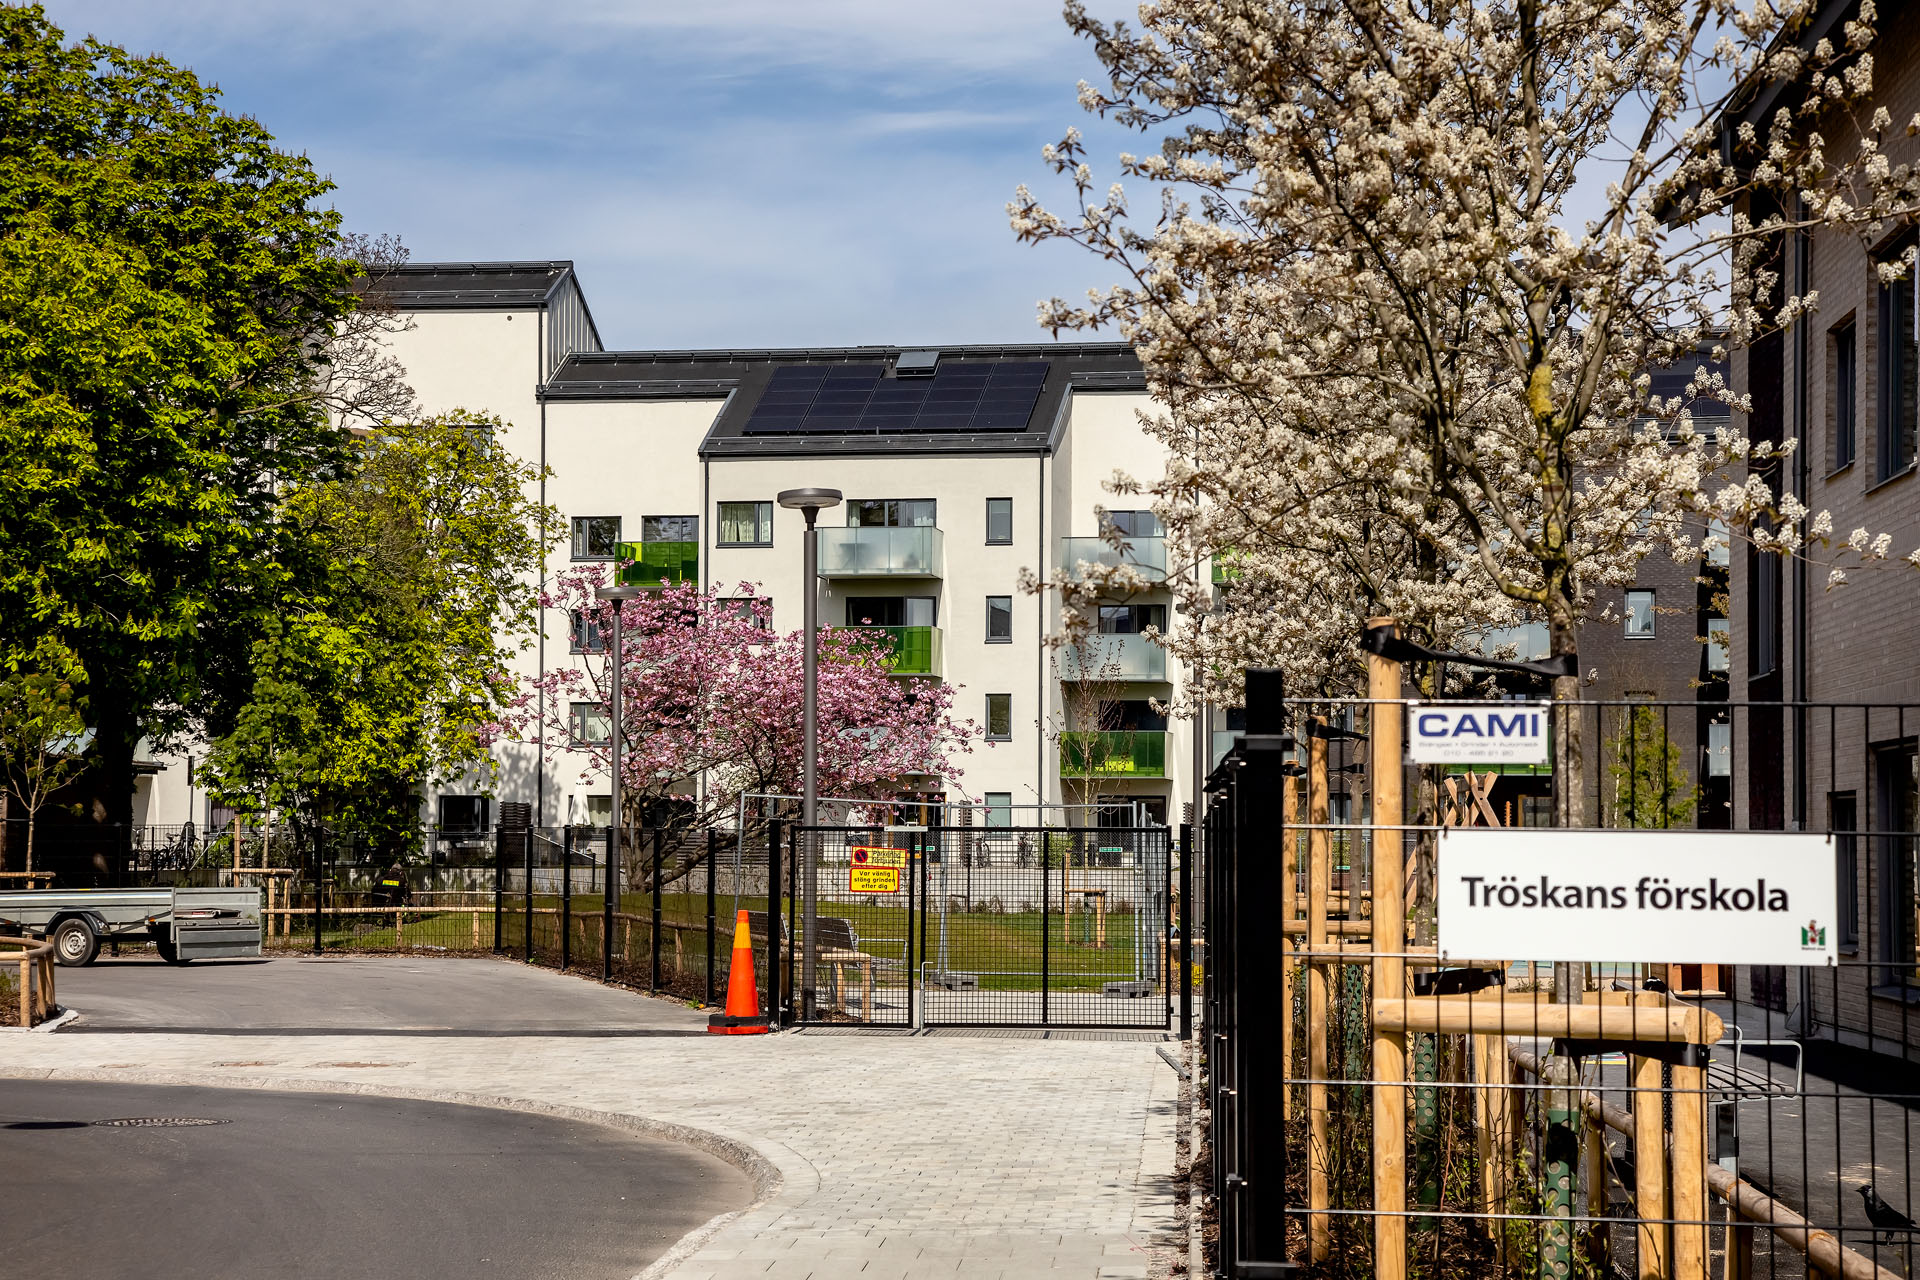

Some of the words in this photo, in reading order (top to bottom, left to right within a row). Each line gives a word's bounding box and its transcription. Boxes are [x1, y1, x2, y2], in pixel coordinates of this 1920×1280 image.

[1418, 713, 1539, 737] CAMI
[1461, 876, 1628, 909] Tröskans
[1635, 877, 1789, 912] förskola
